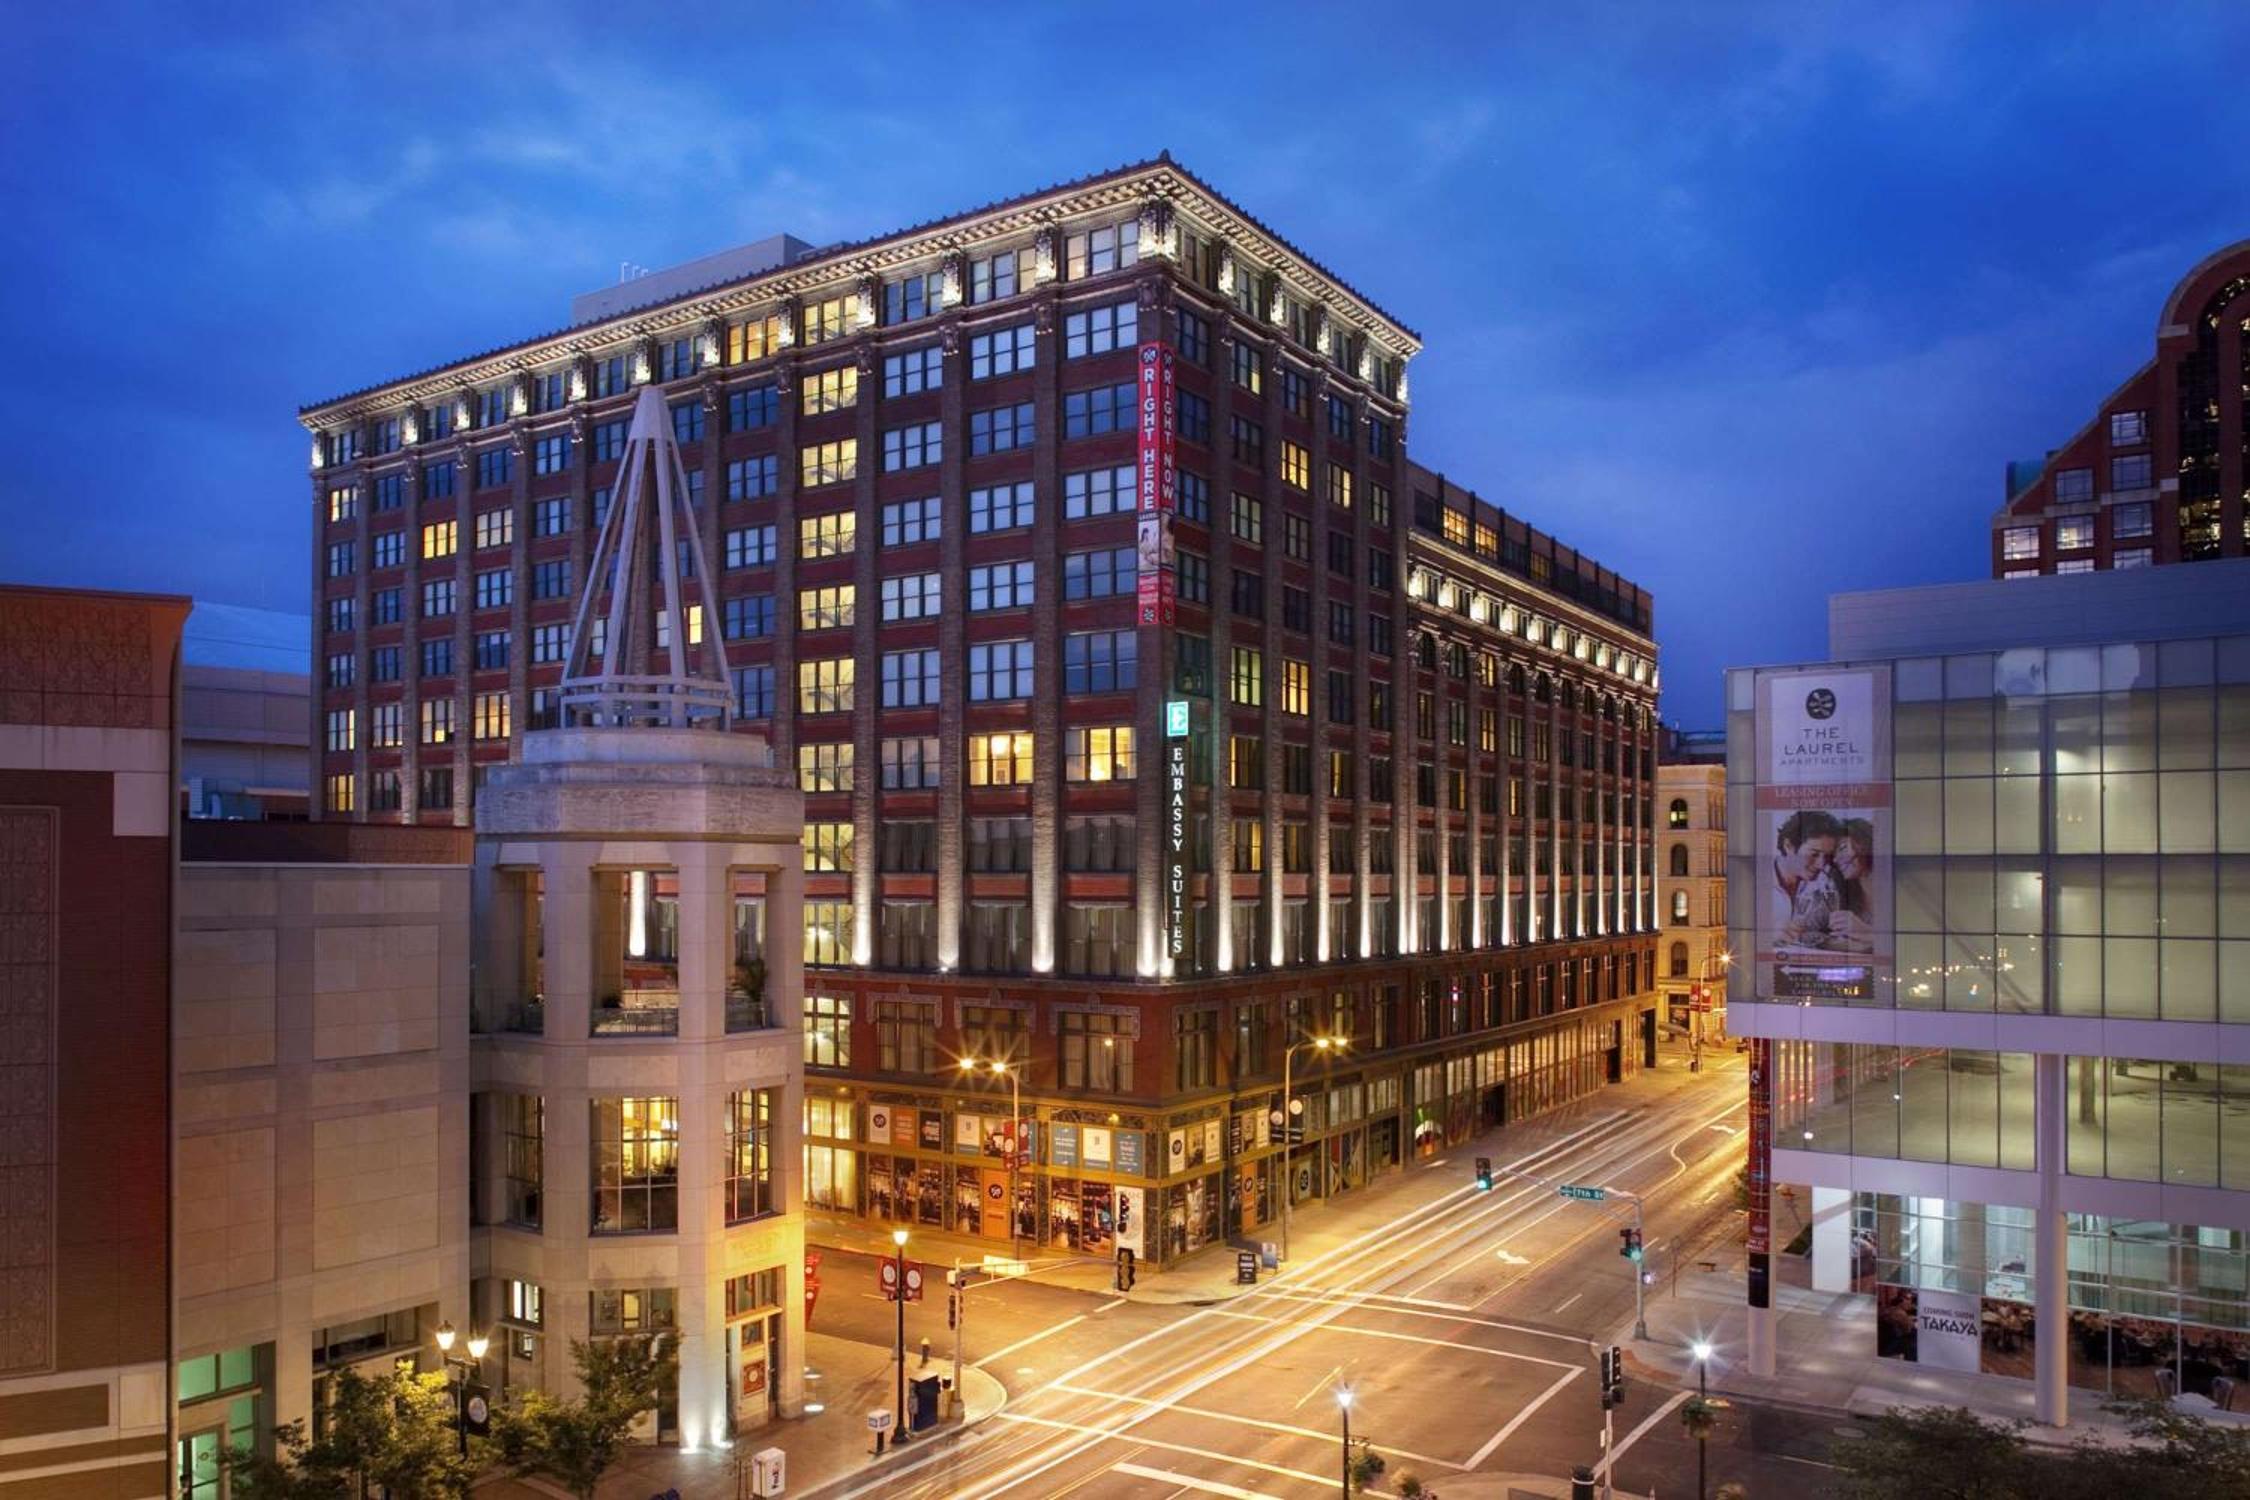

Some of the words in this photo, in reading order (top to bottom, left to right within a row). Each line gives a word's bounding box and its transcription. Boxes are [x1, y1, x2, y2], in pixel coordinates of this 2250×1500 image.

[1143, 367, 1156, 442] RIGHT
[1162, 369, 1173, 445] RIGHT
[1142, 449, 1156, 510] HERE
[1161, 452, 1175, 500] NOW
[1784, 741, 1859, 756] LAUREL
[1802, 727, 1840, 739] THE
[1780, 755, 1865, 767] APARTMENTS
[1170, 747, 1185, 852] EMBASSY
[1172, 864, 1184, 954] SUITES
[1920, 1316, 1978, 1336] TAKAYA
